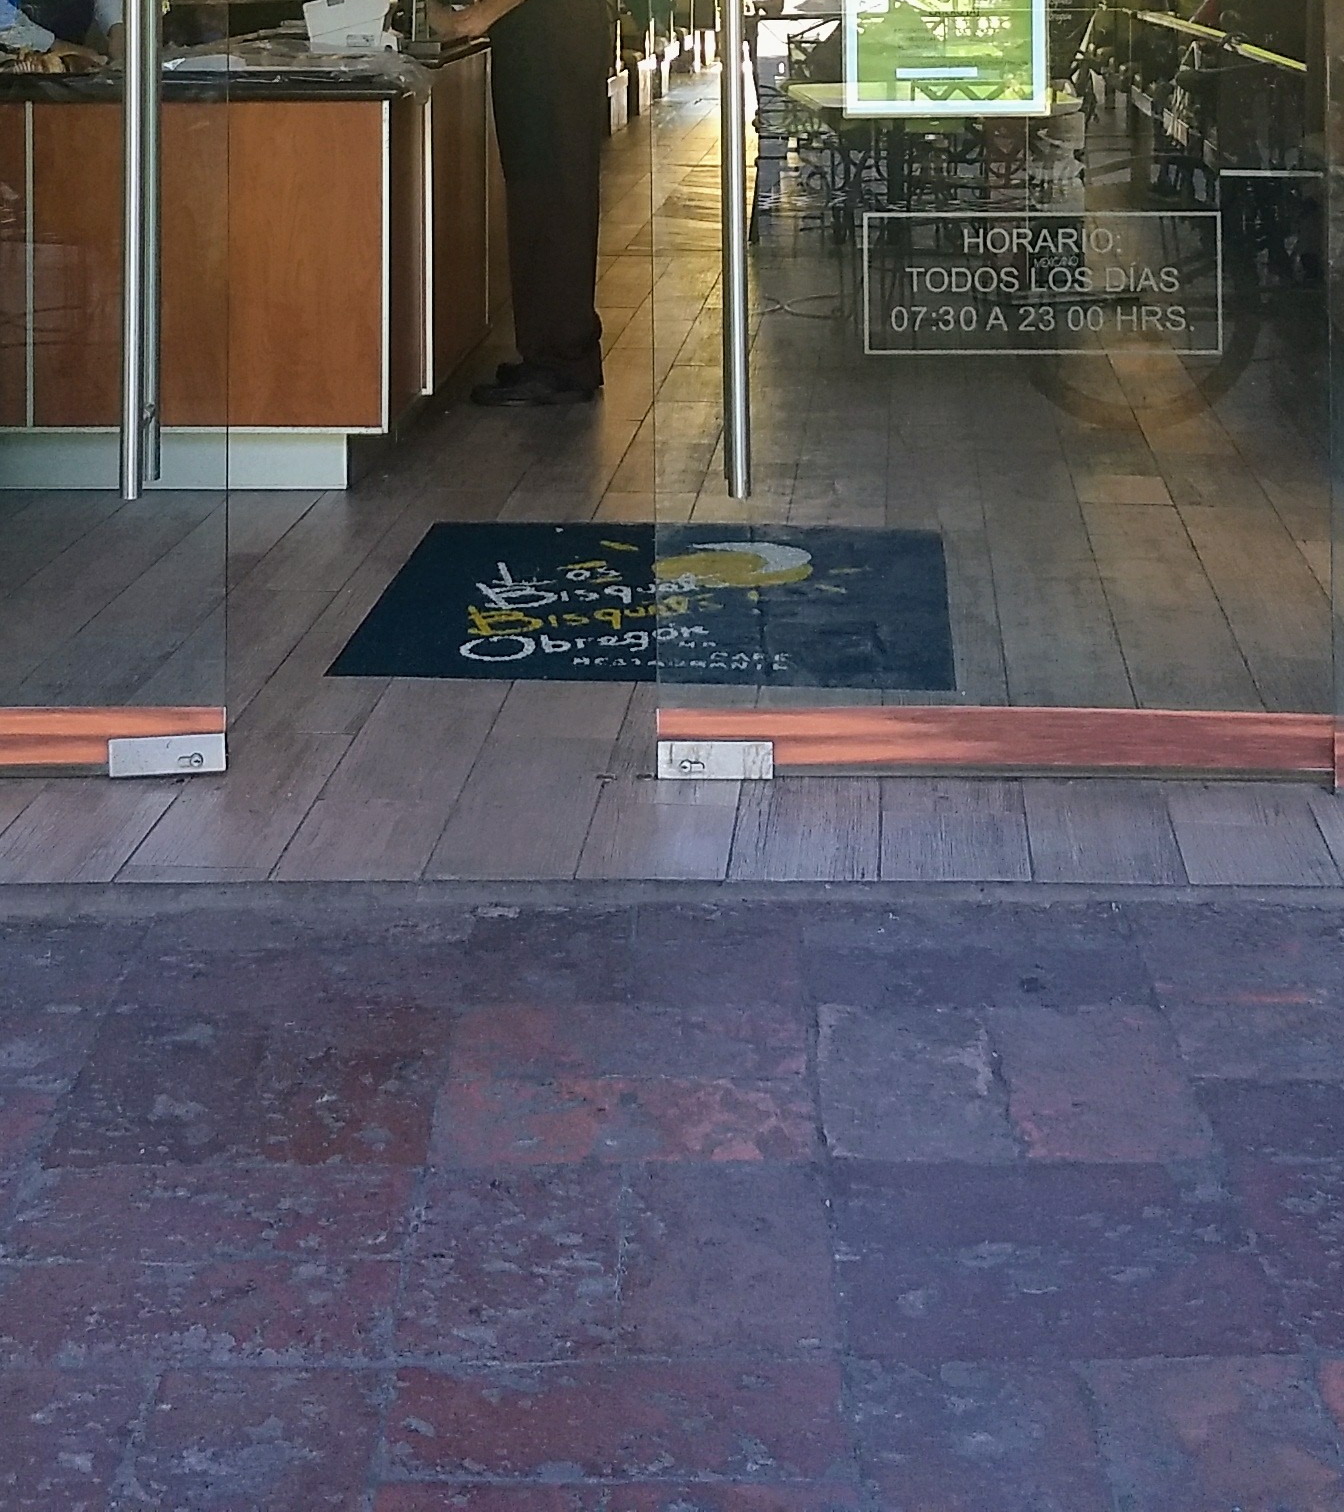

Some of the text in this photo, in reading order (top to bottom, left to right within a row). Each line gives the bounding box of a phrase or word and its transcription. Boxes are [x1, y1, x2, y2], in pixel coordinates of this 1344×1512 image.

[963, 228, 1122, 255] HORARIO:
[905, 261, 1180, 293] TODOS LOS DÍAS
[891, 306, 976, 333] 07:30
[987, 306, 1007, 332] A
[1116, 305, 1195, 332] HRS.
